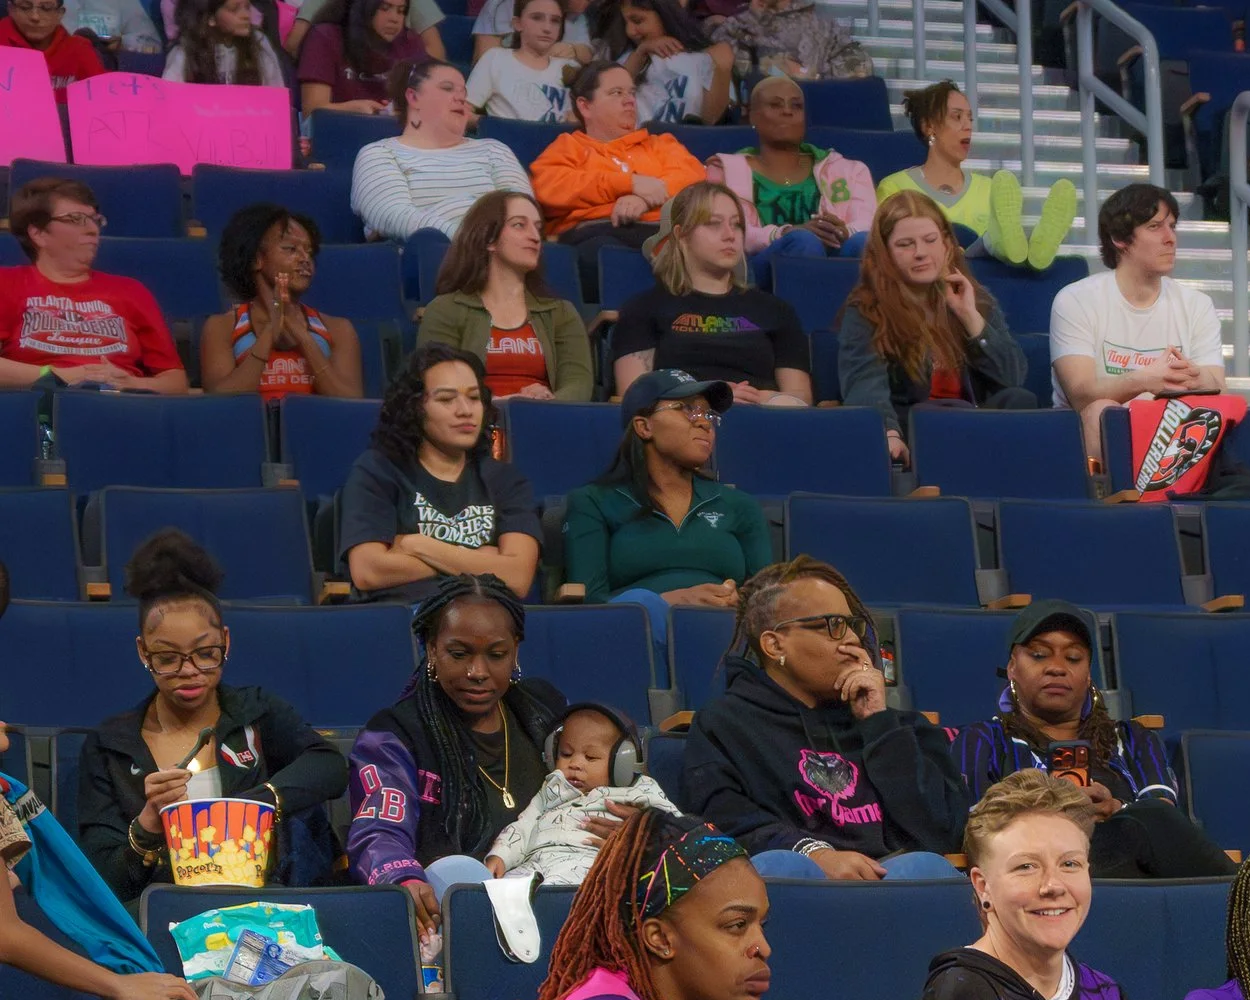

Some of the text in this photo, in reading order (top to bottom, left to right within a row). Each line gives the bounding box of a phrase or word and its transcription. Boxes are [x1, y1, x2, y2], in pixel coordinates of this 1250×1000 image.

[26, 295, 113, 315] ATLANTA JUNIOR
[21, 309, 127, 342] ROLLER DERBY
[1107, 349, 1131, 367] Tiny
[176, 861, 224, 880] Popcorn
